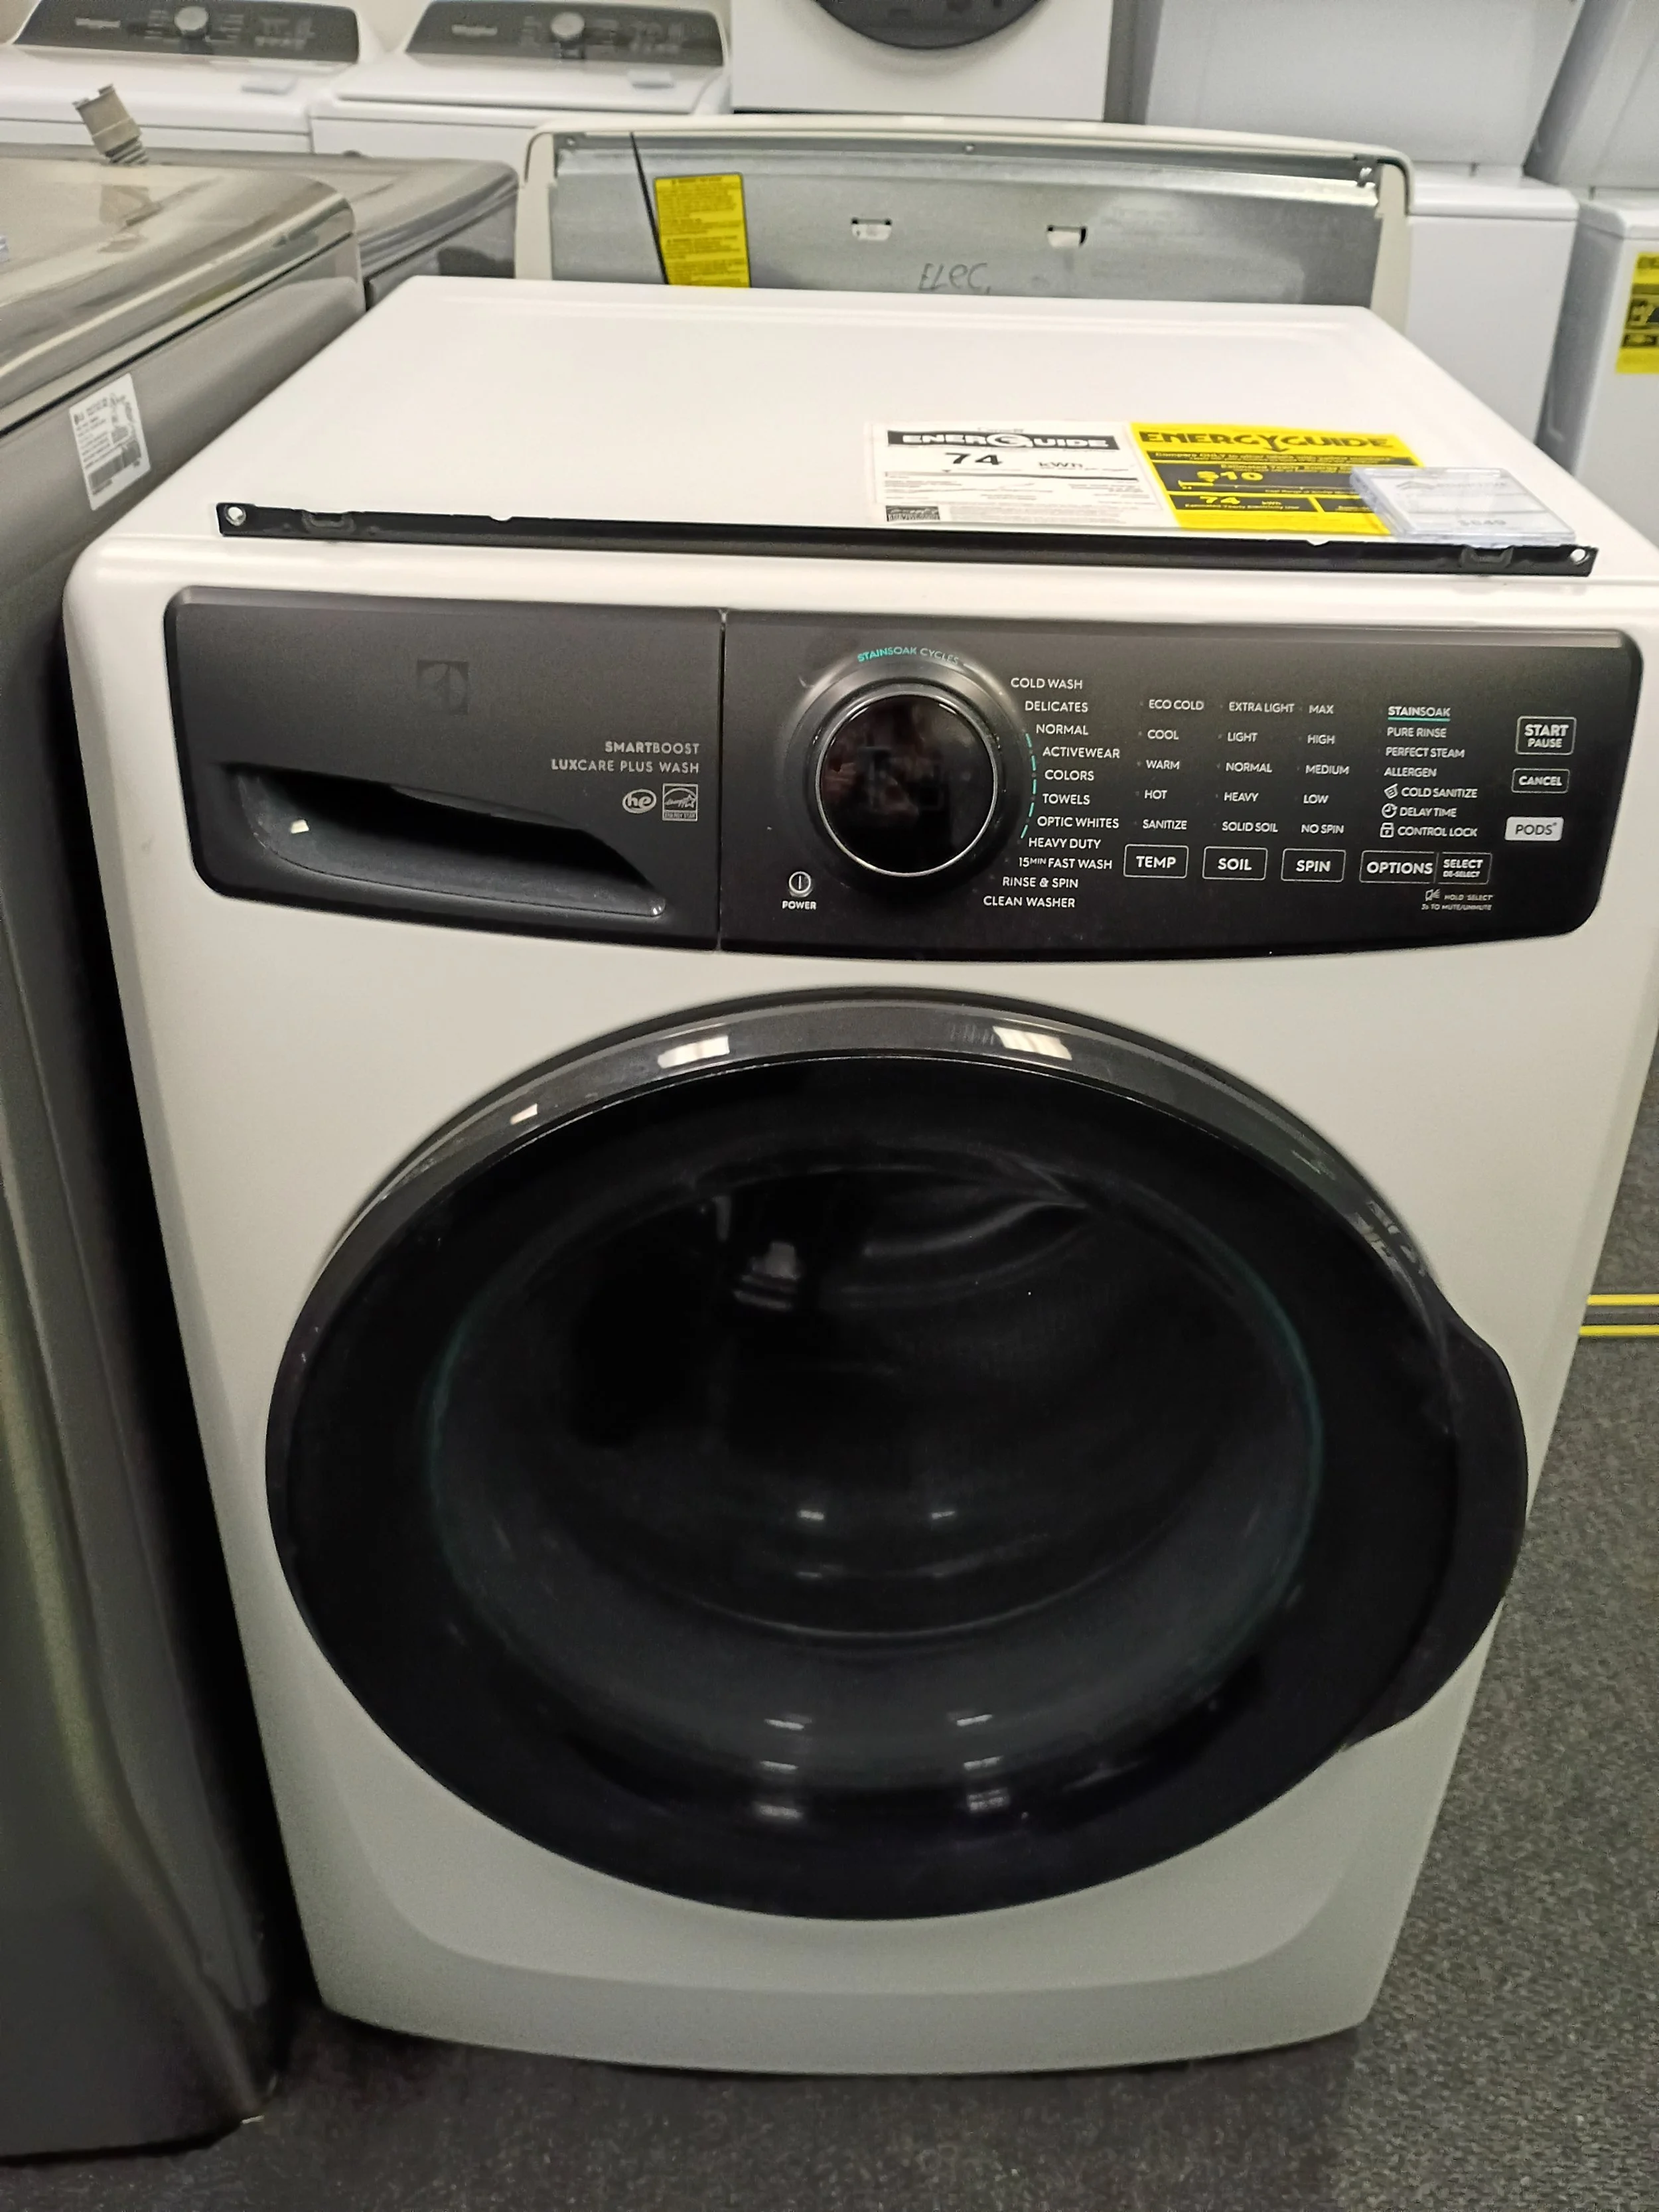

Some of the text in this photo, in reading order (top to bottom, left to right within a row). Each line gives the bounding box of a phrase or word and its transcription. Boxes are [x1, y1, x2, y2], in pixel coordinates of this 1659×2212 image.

[1139, 431, 1394, 452] ENERGYGUIDE
[945, 453, 1003, 466] 74
[1200, 495, 1240, 504] 74
[858, 646, 959, 664] STAINSOAK CYCLES
[1011, 678, 1083, 690] COLD WASH
[1025, 700, 1088, 713] DELICATES
[1149, 699, 1204, 711] ECO COLD
[1229, 701, 1295, 713] EXTRA LIGHT
[1309, 703, 1334, 715] MAX
[1388, 705, 1451, 717] STAINSOAK
[1036, 723, 1088, 736] NORMAL
[1147, 729, 1179, 741] COOL
[1387, 727, 1447, 738] PURE RINSE
[1524, 723, 1569, 737] START
[1227, 732, 1258, 743] LIGHT
[1307, 734, 1335, 745] HIGH
[1528, 738, 1563, 749] PAUSE
[605, 741, 699, 755] SMARTBOOST
[1043, 746, 1121, 759] ACTIVEWEAR
[1386, 747, 1465, 759] PERFECT STEAM
[551, 759, 699, 774] LUXCARE PLUS WASH
[1146, 760, 1180, 771] WARM
[1226, 762, 1273, 773] NORMAL
[1305, 764, 1350, 775] MEDIUM
[1045, 769, 1094, 781] COLORS
[1384, 767, 1437, 778] ALLERGEN
[1518, 775, 1563, 786] CANCEL
[1144, 790, 1167, 800] HOT
[1224, 792, 1259, 802] HEAVY
[1401, 787, 1478, 798] COLD SANITIZE
[627, 792, 652, 808] he
[1043, 793, 1090, 806] TOWELS
[1303, 794, 1329, 804] LOW
[1400, 806, 1457, 818] DELAY TIME
[1037, 816, 1119, 829] OPTIC WHITES
[1142, 819, 1188, 830] SANITIZE
[1222, 822, 1278, 833] SOLID SOIL
[1301, 824, 1344, 835] NO SPIN
[1398, 826, 1478, 838] CONTROL LOCK
[1029, 838, 1101, 849] HEAVY DUTY
[1048, 858, 1075, 869] FAST
[1078, 859, 1112, 870] WASH
[1136, 855, 1177, 869] TEMP
[1218, 857, 1252, 871] SOIL
[1296, 859, 1331, 872] SPIN
[1366, 861, 1433, 875] OPTIONS
[1443, 859, 1483, 869] SELECT
[1002, 877, 1078, 889] RINSE & SPIN
[782, 900, 816, 911] POWER
[983, 896, 1076, 908] CLEAN WASHER
